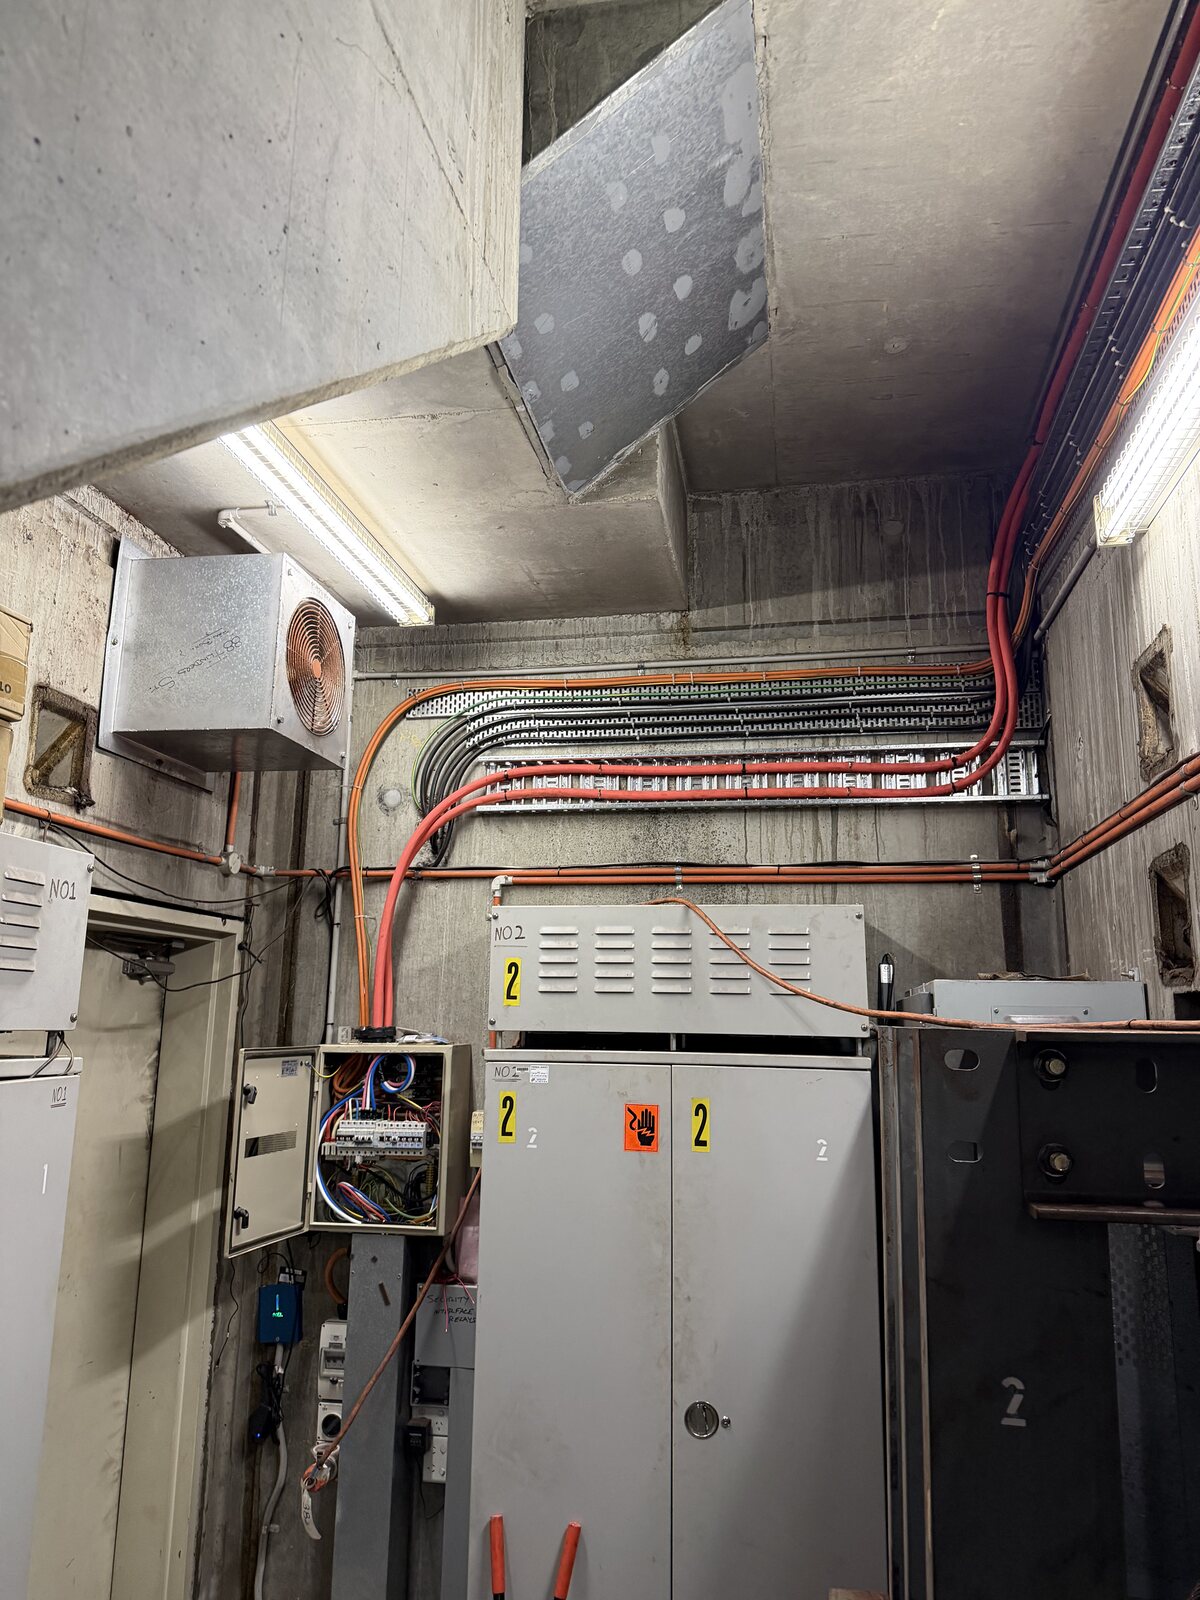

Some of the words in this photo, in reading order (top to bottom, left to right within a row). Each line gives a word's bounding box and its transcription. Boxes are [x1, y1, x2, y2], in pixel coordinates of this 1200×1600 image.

[223, 636, 242, 652] 88
[50, 878, 76, 900] NO1
[506, 962, 519, 1000] 2
[501, 1096, 515, 1136] 2
[694, 1103, 708, 1147] 2
[526, 1127, 538, 1149] 2
[816, 1139, 828, 1162] 2
[1001, 1376, 1027, 1427] 2
